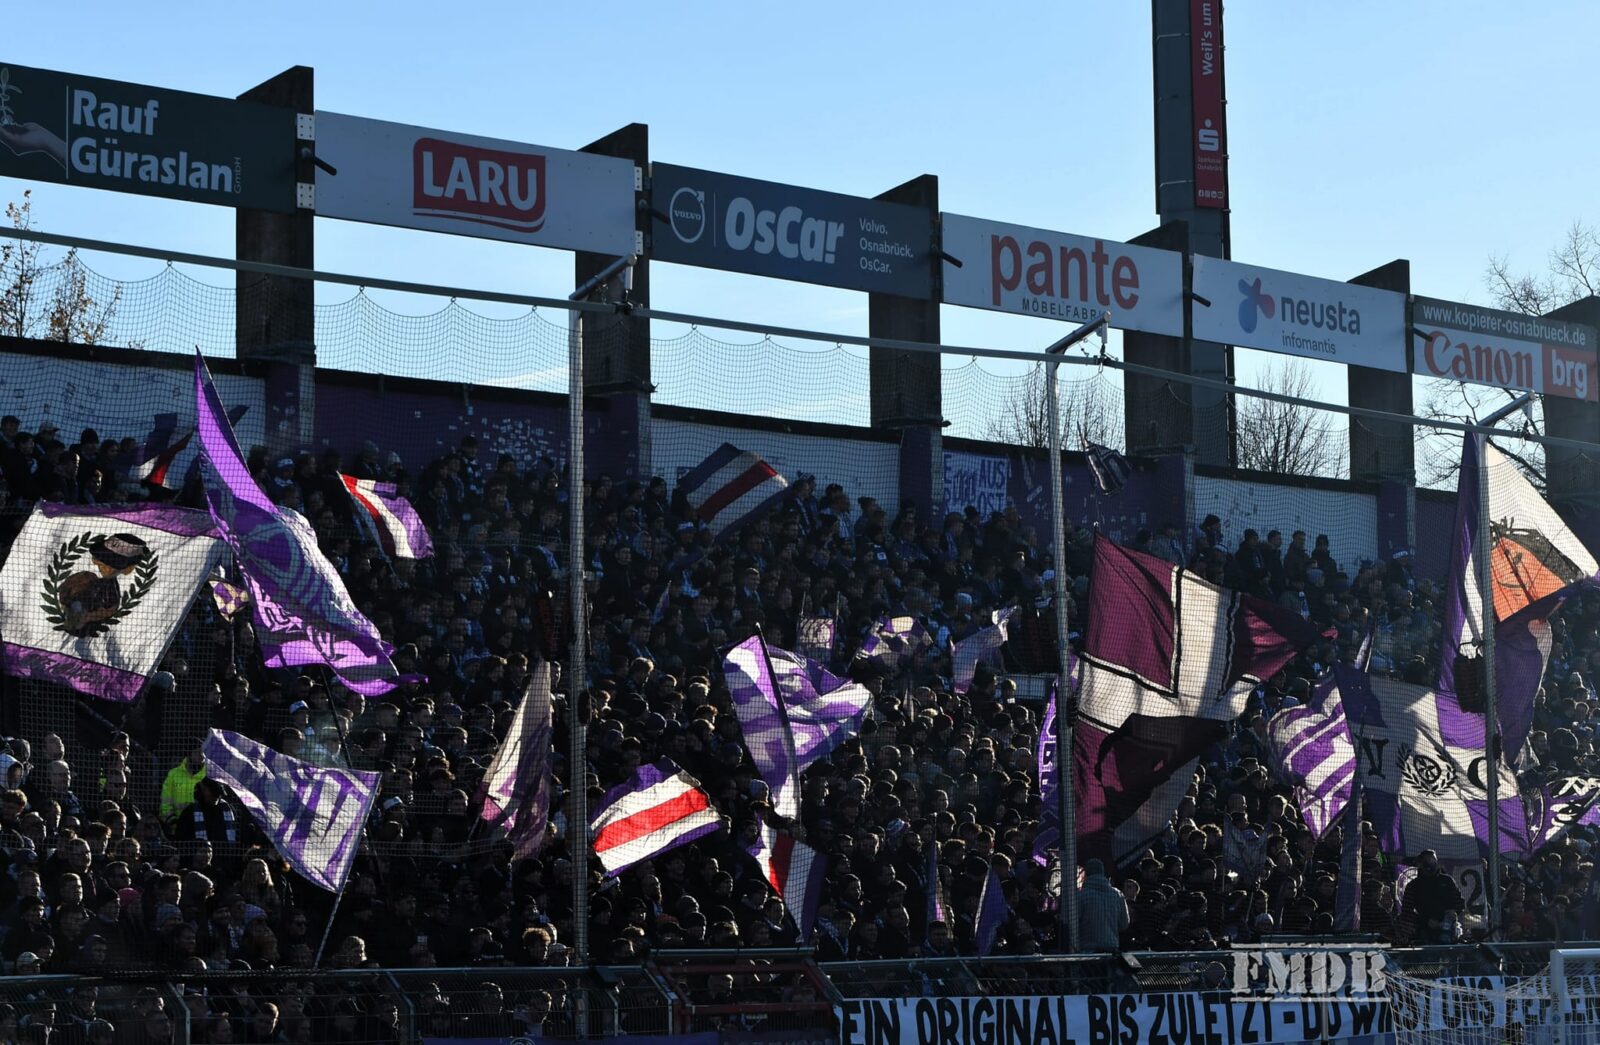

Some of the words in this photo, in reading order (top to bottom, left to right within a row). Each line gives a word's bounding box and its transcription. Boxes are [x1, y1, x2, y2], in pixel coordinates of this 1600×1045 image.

[1202, 2, 1212, 25] um
[1201, 31, 1213, 75] Weil's
[73, 89, 159, 136] Rauf
[70, 136, 233, 192] Güraslan
[233, 157, 242, 194] GmbH
[422, 151, 537, 211] LARU
[674, 210, 702, 220] VOLVO
[859, 217, 888, 235] Volvo.
[859, 238, 914, 258] Osnabrück.
[859, 258, 892, 274] OsCar.
[991, 234, 1140, 310] pante
[1280, 296, 1361, 336] neusta
[1423, 304, 1586, 346] www.kopierer-osnabrueck.de
[1282, 333, 1336, 355] infomantis
[1424, 330, 1533, 388] Canon
[1551, 349, 1587, 399] brg
[841, 999, 900, 1045] EIN
[916, 998, 1075, 1045] ORIGINAL
[1088, 994, 1139, 1045] BIS
[1441, 977, 1495, 1028] UNS
